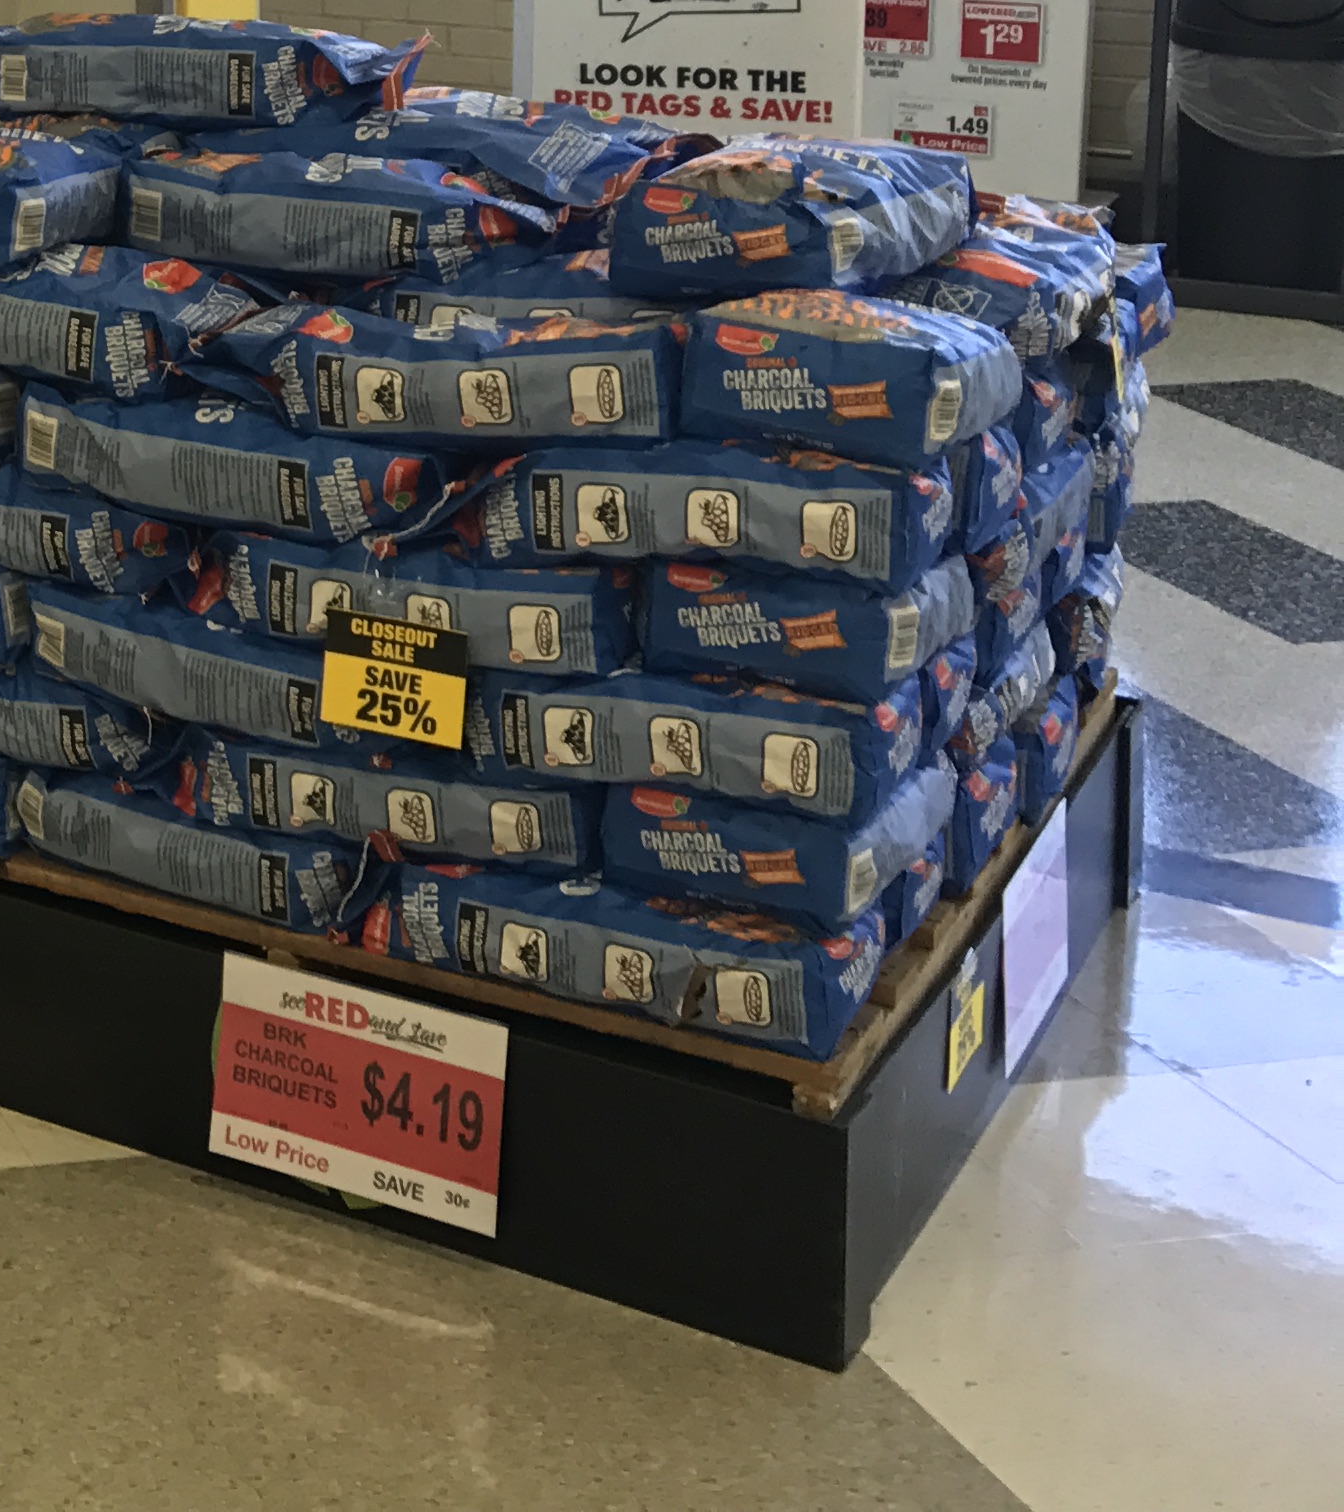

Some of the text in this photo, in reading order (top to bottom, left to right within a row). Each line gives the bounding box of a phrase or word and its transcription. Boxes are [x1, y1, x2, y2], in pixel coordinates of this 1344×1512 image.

[262, 61, 296, 126] BRIQUETS
[277, 44, 308, 115] CHARCOAL
[578, 62, 807, 94] LOOK FOR THE
[1009, 79, 1031, 90] every
[1032, 79, 1048, 91] day
[621, 91, 702, 118] TAGS
[709, 95, 732, 119] &
[740, 96, 834, 125] SAVE!
[946, 115, 989, 136] 1.49
[919, 136, 987, 153] Low Price
[645, 219, 723, 247] CHARCOAL
[661, 236, 735, 264] BRIQUETS
[79, 326, 92, 369] FOR SAFE
[104, 325, 136, 398] BRIQUETS
[121, 310, 151, 389] CHARCOAL
[723, 368, 814, 390] CHARCOAL
[741, 388, 827, 414] BRIQUETS
[315, 474, 355, 544] BRIQUETS
[333, 456, 373, 535] CHARCOAL
[534, 490, 547, 536] LIGHTING
[549, 477, 562, 548] INSTRUCTIONS
[677, 601, 767, 627] CHARCOAL
[350, 616, 438, 649] CLOSEOUT
[697, 622, 782, 649] BRIQUETS
[371, 640, 415, 664] SALE
[364, 665, 423, 696] SAVE
[355, 688, 438, 736] 25%
[640, 829, 728, 854] CHARCOAL
[659, 850, 741, 876] BRIQUETS
[303, 990, 371, 1031] RED
[263, 1021, 308, 1050] BRK
[234, 1038, 339, 1085] CHARCOAL
[232, 1060, 485, 1153] BRIQUETS $4.19
[224, 1123, 271, 1156] Low
[274, 1137, 331, 1174] Price
[372, 1170, 426, 1204] SAVE
